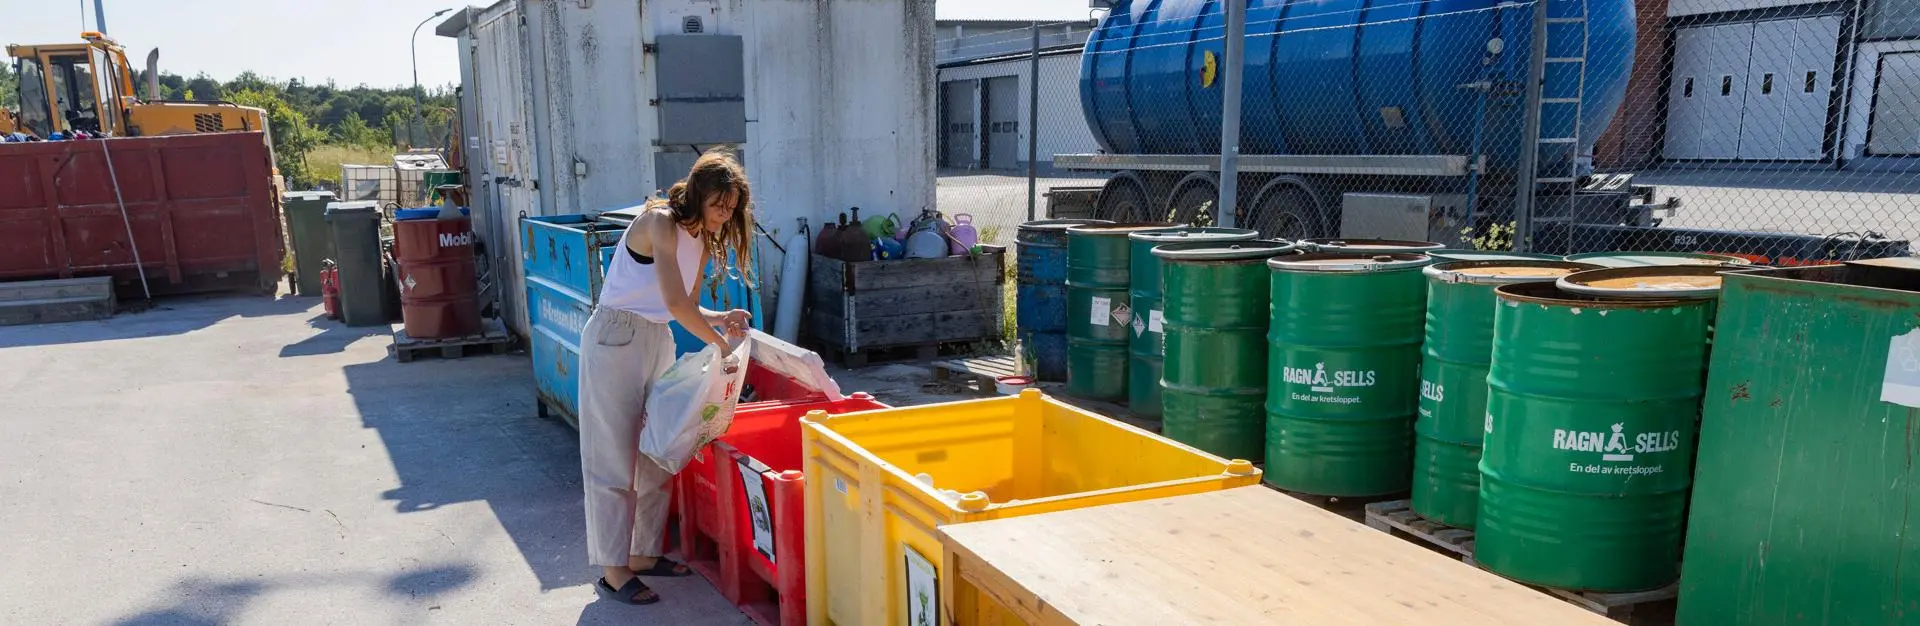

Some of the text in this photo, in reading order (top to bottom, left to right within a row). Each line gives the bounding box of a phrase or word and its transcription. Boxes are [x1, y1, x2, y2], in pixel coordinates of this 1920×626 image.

[1674, 235, 1697, 245] 6324
[1283, 366, 1375, 387] RAGN SELLS
[1291, 392, 1300, 400] En
[1300, 394, 1311, 402] del
[1553, 428, 1680, 453] RAGN SELLS
[1569, 462, 1583, 473] En
[1584, 463, 1601, 474] del
[1601, 466, 1613, 474] av
